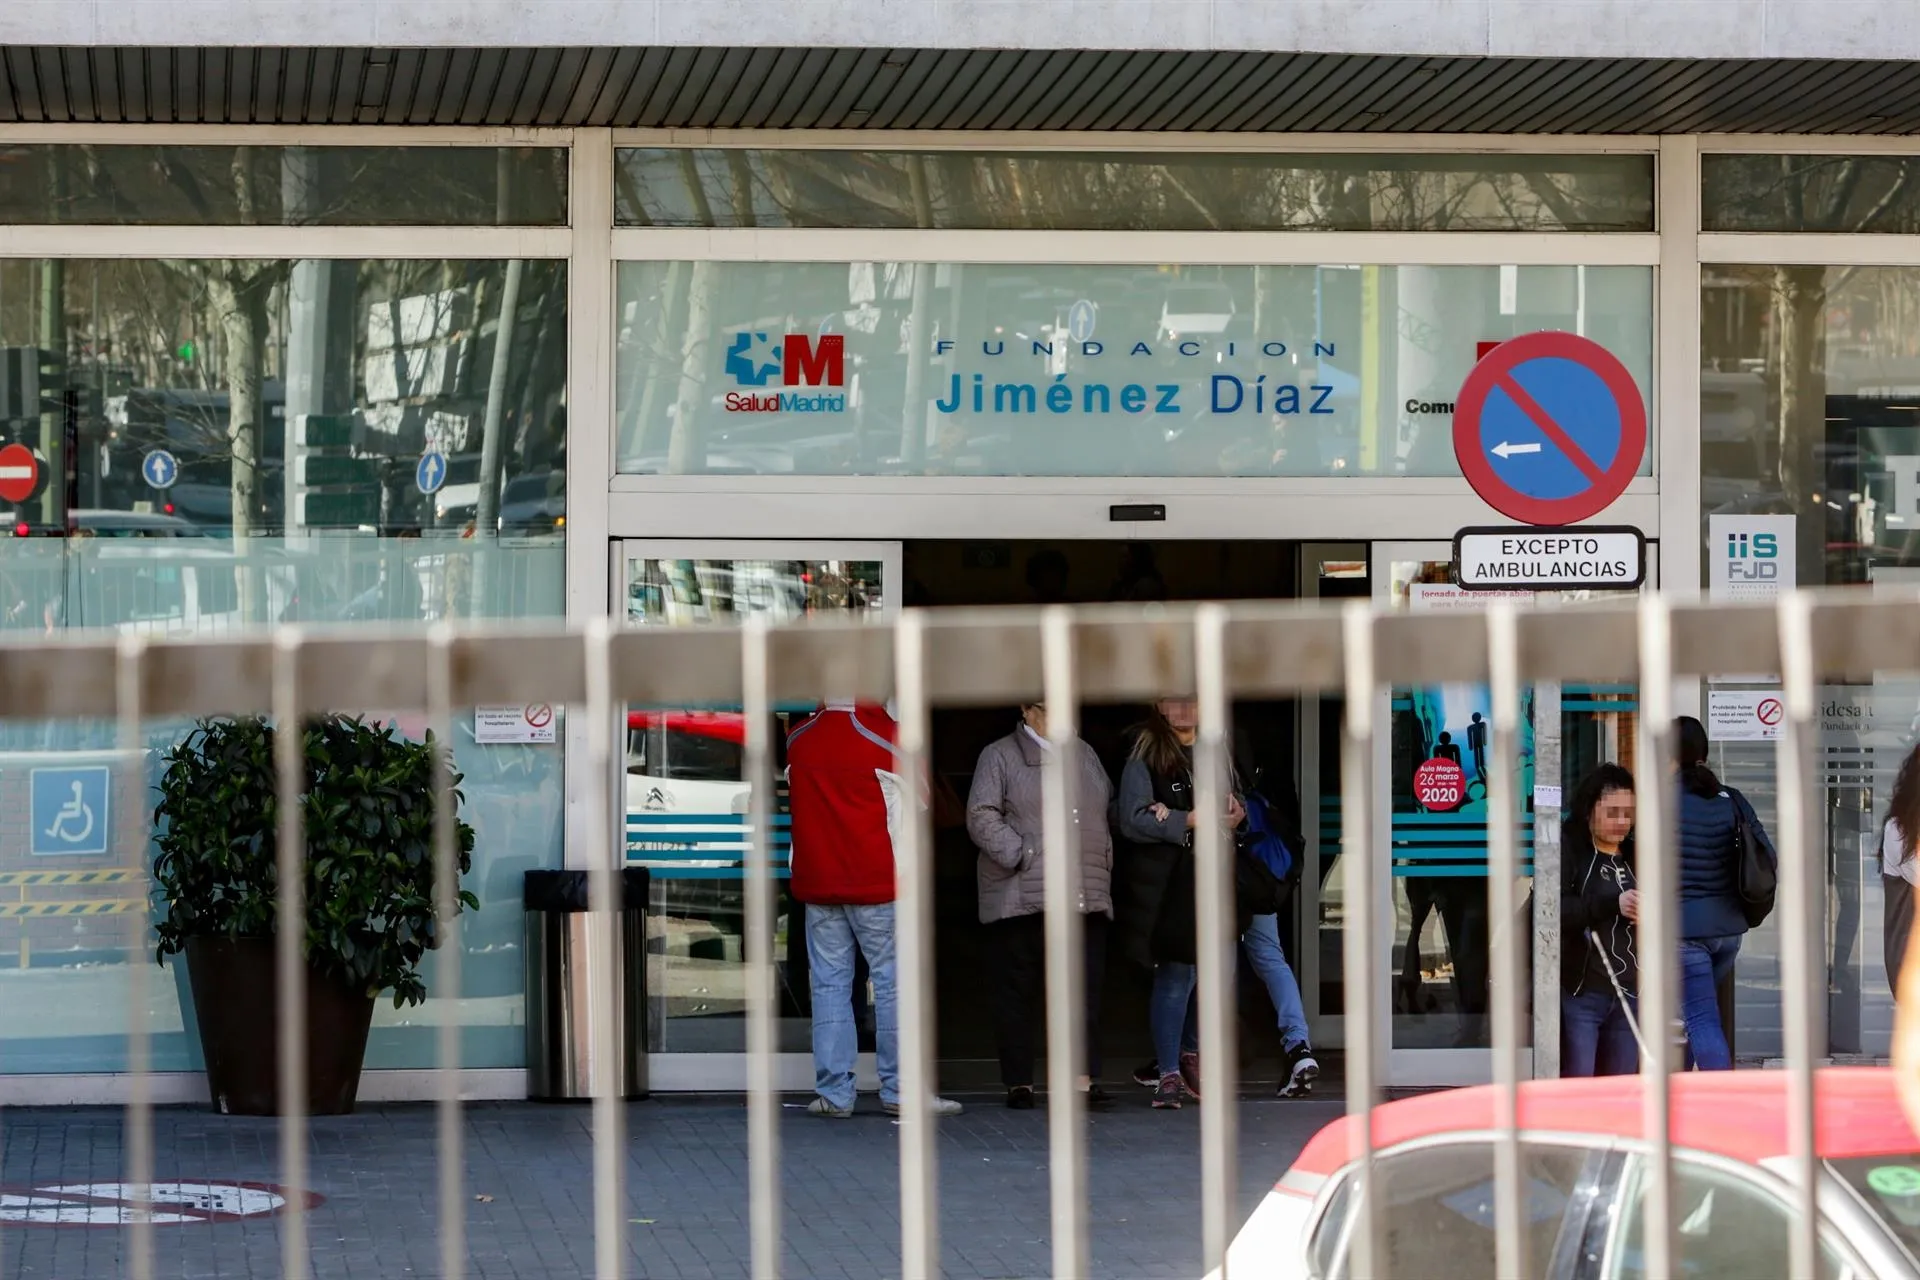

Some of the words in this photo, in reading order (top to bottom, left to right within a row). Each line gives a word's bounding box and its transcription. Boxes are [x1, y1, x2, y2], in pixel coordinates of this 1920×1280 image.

[937, 341, 1335, 357] FUNDACION
[725, 392, 845, 412] SaludMadrid
[936, 373, 1181, 414] Jiménez
[1211, 374, 1335, 415] Díaz
[1502, 538, 1599, 555] EXCEPTO
[1475, 561, 1627, 578] AMBULANCIAS
[1728, 561, 1778, 579] FJD
[1459, 590, 1470, 598] de
[1420, 765, 1435, 773] Aula
[1436, 765, 1460, 774] Magna
[1419, 773, 1435, 786] 26
[1421, 787, 1458, 802] 2020
